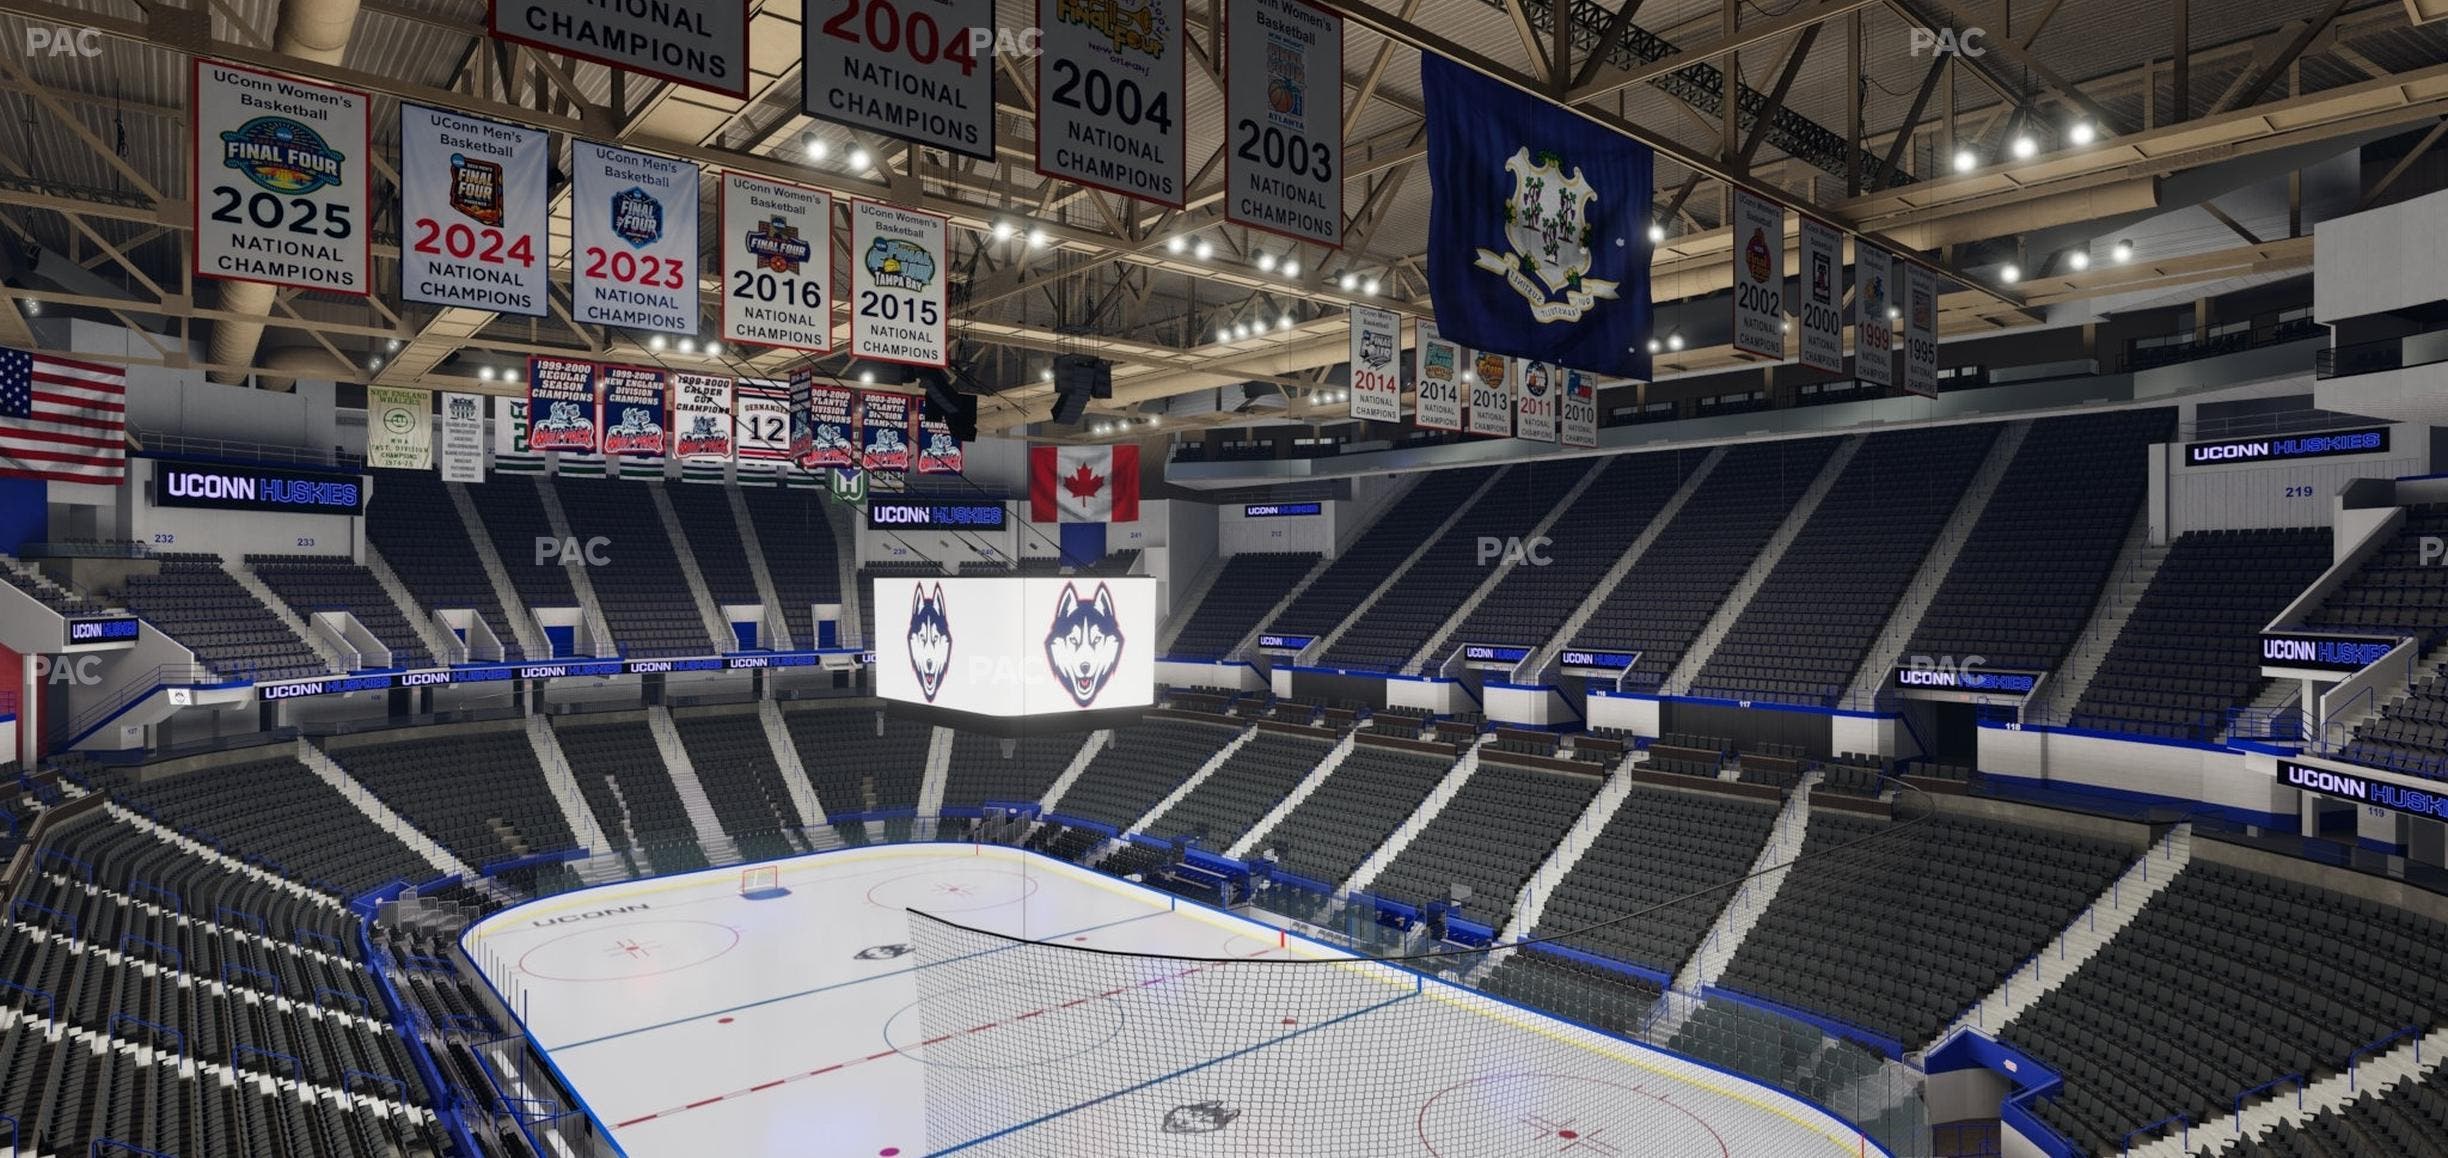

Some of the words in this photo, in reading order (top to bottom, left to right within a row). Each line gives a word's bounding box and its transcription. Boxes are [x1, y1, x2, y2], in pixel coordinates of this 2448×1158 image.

[1281, 0, 1332, 32] Women's
[823, 0, 979, 77] 2004
[1256, 11, 1316, 46] Basketball
[526, 5, 727, 79] CHAMPIONS
[214, 69, 272, 92] UConn
[277, 83, 352, 108] Women's
[844, 55, 968, 110] NATIONAL
[240, 93, 328, 120] Basketball
[1052, 58, 1172, 135] 2004
[828, 88, 978, 145] CHAMPIONS
[431, 114, 478, 134] UConn
[483, 125, 522, 143] Men's
[440, 133, 513, 158] Basketball
[1068, 120, 1164, 164] NATIONAL
[1238, 118, 1332, 183] 2003
[228, 142, 284, 163] FINAL
[288, 150, 338, 176] FOUR
[596, 147, 639, 166] UConn
[643, 157, 678, 174] Men's
[458, 168, 493, 187] FINAL
[605, 166, 669, 187] Basketball
[1056, 149, 1173, 195] CHAMPIONS
[458, 181, 493, 200] FOUR
[734, 178, 771, 194] UConn
[774, 186, 821, 205] Women's
[1250, 173, 1326, 210] NATIONAL
[212, 186, 351, 239] 2025
[621, 200, 655, 219] FINAL
[750, 196, 806, 215] Basketball
[623, 215, 657, 232] FOUR
[861, 205, 893, 220] UConn
[896, 212, 938, 229] Women's
[1241, 198, 1333, 236] CHAMPIONS
[875, 221, 924, 238] Basketball
[232, 233, 344, 262] NATIONAL
[414, 218, 535, 268] 2024
[751, 238, 779, 252] FINAL
[780, 242, 806, 256] FOUR
[218, 255, 354, 285] CHAMPIONS
[429, 261, 524, 287] NATIONAL
[585, 246, 684, 289] 2023
[733, 270, 821, 309] 2016
[875, 271, 904, 286] TAMPA
[905, 276, 922, 292] BAY
[420, 281, 531, 308] CHAMPIONS
[595, 287, 679, 310] NATIONAL
[1739, 282, 1779, 318] 2002
[587, 306, 685, 329] CHAMPIONS
[745, 306, 816, 327] NATIONAL
[861, 290, 938, 326] 2015
[1743, 317, 1777, 335] NATIONAL
[1804, 302, 1839, 336] 2000
[736, 324, 822, 345] CHAMPIONS
[870, 324, 933, 343] NATIONAL
[1740, 333, 1779, 353] CHAMPIONS
[1808, 335, 1837, 352] NATIONAL
[1859, 321, 1889, 351] 1999
[863, 341, 938, 360] CHAMPIONS
[1805, 350, 1840, 369] CHAMPIONS
[1908, 336, 1935, 364] 1995
[537, 360, 592, 373] 1999-2000
[539, 370, 588, 383] REGULAR
[612, 369, 656, 381] 1999-2000
[541, 379, 584, 391] SEASON
[604, 377, 624, 387] NEW
[625, 379, 665, 390] ENGLAND
[615, 386, 654, 397] DIVISION
[678, 375, 730, 388] 1999-2000
[684, 385, 723, 396] CALDER
[1354, 370, 1396, 394] 2014
[531, 388, 594, 402] CHAMPIONS
[609, 394, 659, 405] CHAMPIONS
[694, 395, 713, 404] CUP
[1360, 394, 1394, 407] NATIONAL
[1420, 381, 1457, 403] 2014
[1473, 389, 1507, 411] 2013
[676, 403, 730, 414] CHAMPIONS
[1356, 406, 1397, 419] CHAMPIONS
[1424, 403, 1455, 415] NATIONAL
[1477, 412, 1505, 422] NATIONAL
[1520, 397, 1551, 417] 2011
[1564, 404, 1594, 423] 2010
[749, 414, 786, 444] 12
[1421, 415, 1458, 427] CHAMPIONS
[1474, 422, 1508, 433] CHAMPIONS
[2194, 442, 2269, 460] UCONN
[2273, 432, 2380, 455] HUSKIES
[168, 472, 255, 500] UCONN
[260, 478, 357, 506] HUSKIES
[2285, 486, 2313, 498] 219
[874, 506, 930, 523] UCONN
[932, 506, 1002, 525] HUSKIES
[1247, 507, 1278, 516] UCONN
[154, 534, 174, 544] 232
[297, 538, 315, 547] 233
[73, 623, 102, 639] UCONN
[1260, 637, 1283, 647] UCONN
[2263, 639, 2315, 660] UCONN
[730, 657, 768, 668] UCONN
[1466, 647, 1493, 660] UCONN
[1562, 652, 1593, 665] UCONN
[521, 666, 566, 678] UCONN
[630, 661, 671, 673] UCONN
[402, 672, 450, 686] UCONN
[1900, 670, 1955, 686] UCONN
[1957, 672, 2033, 691] HUSKIES
[265, 682, 323, 699] UCONN
[2005, 722, 2021, 731] 118
[2289, 766, 2366, 798] UCONN
[2368, 806, 2385, 818] 119
[533, 903, 650, 927] UCONN
